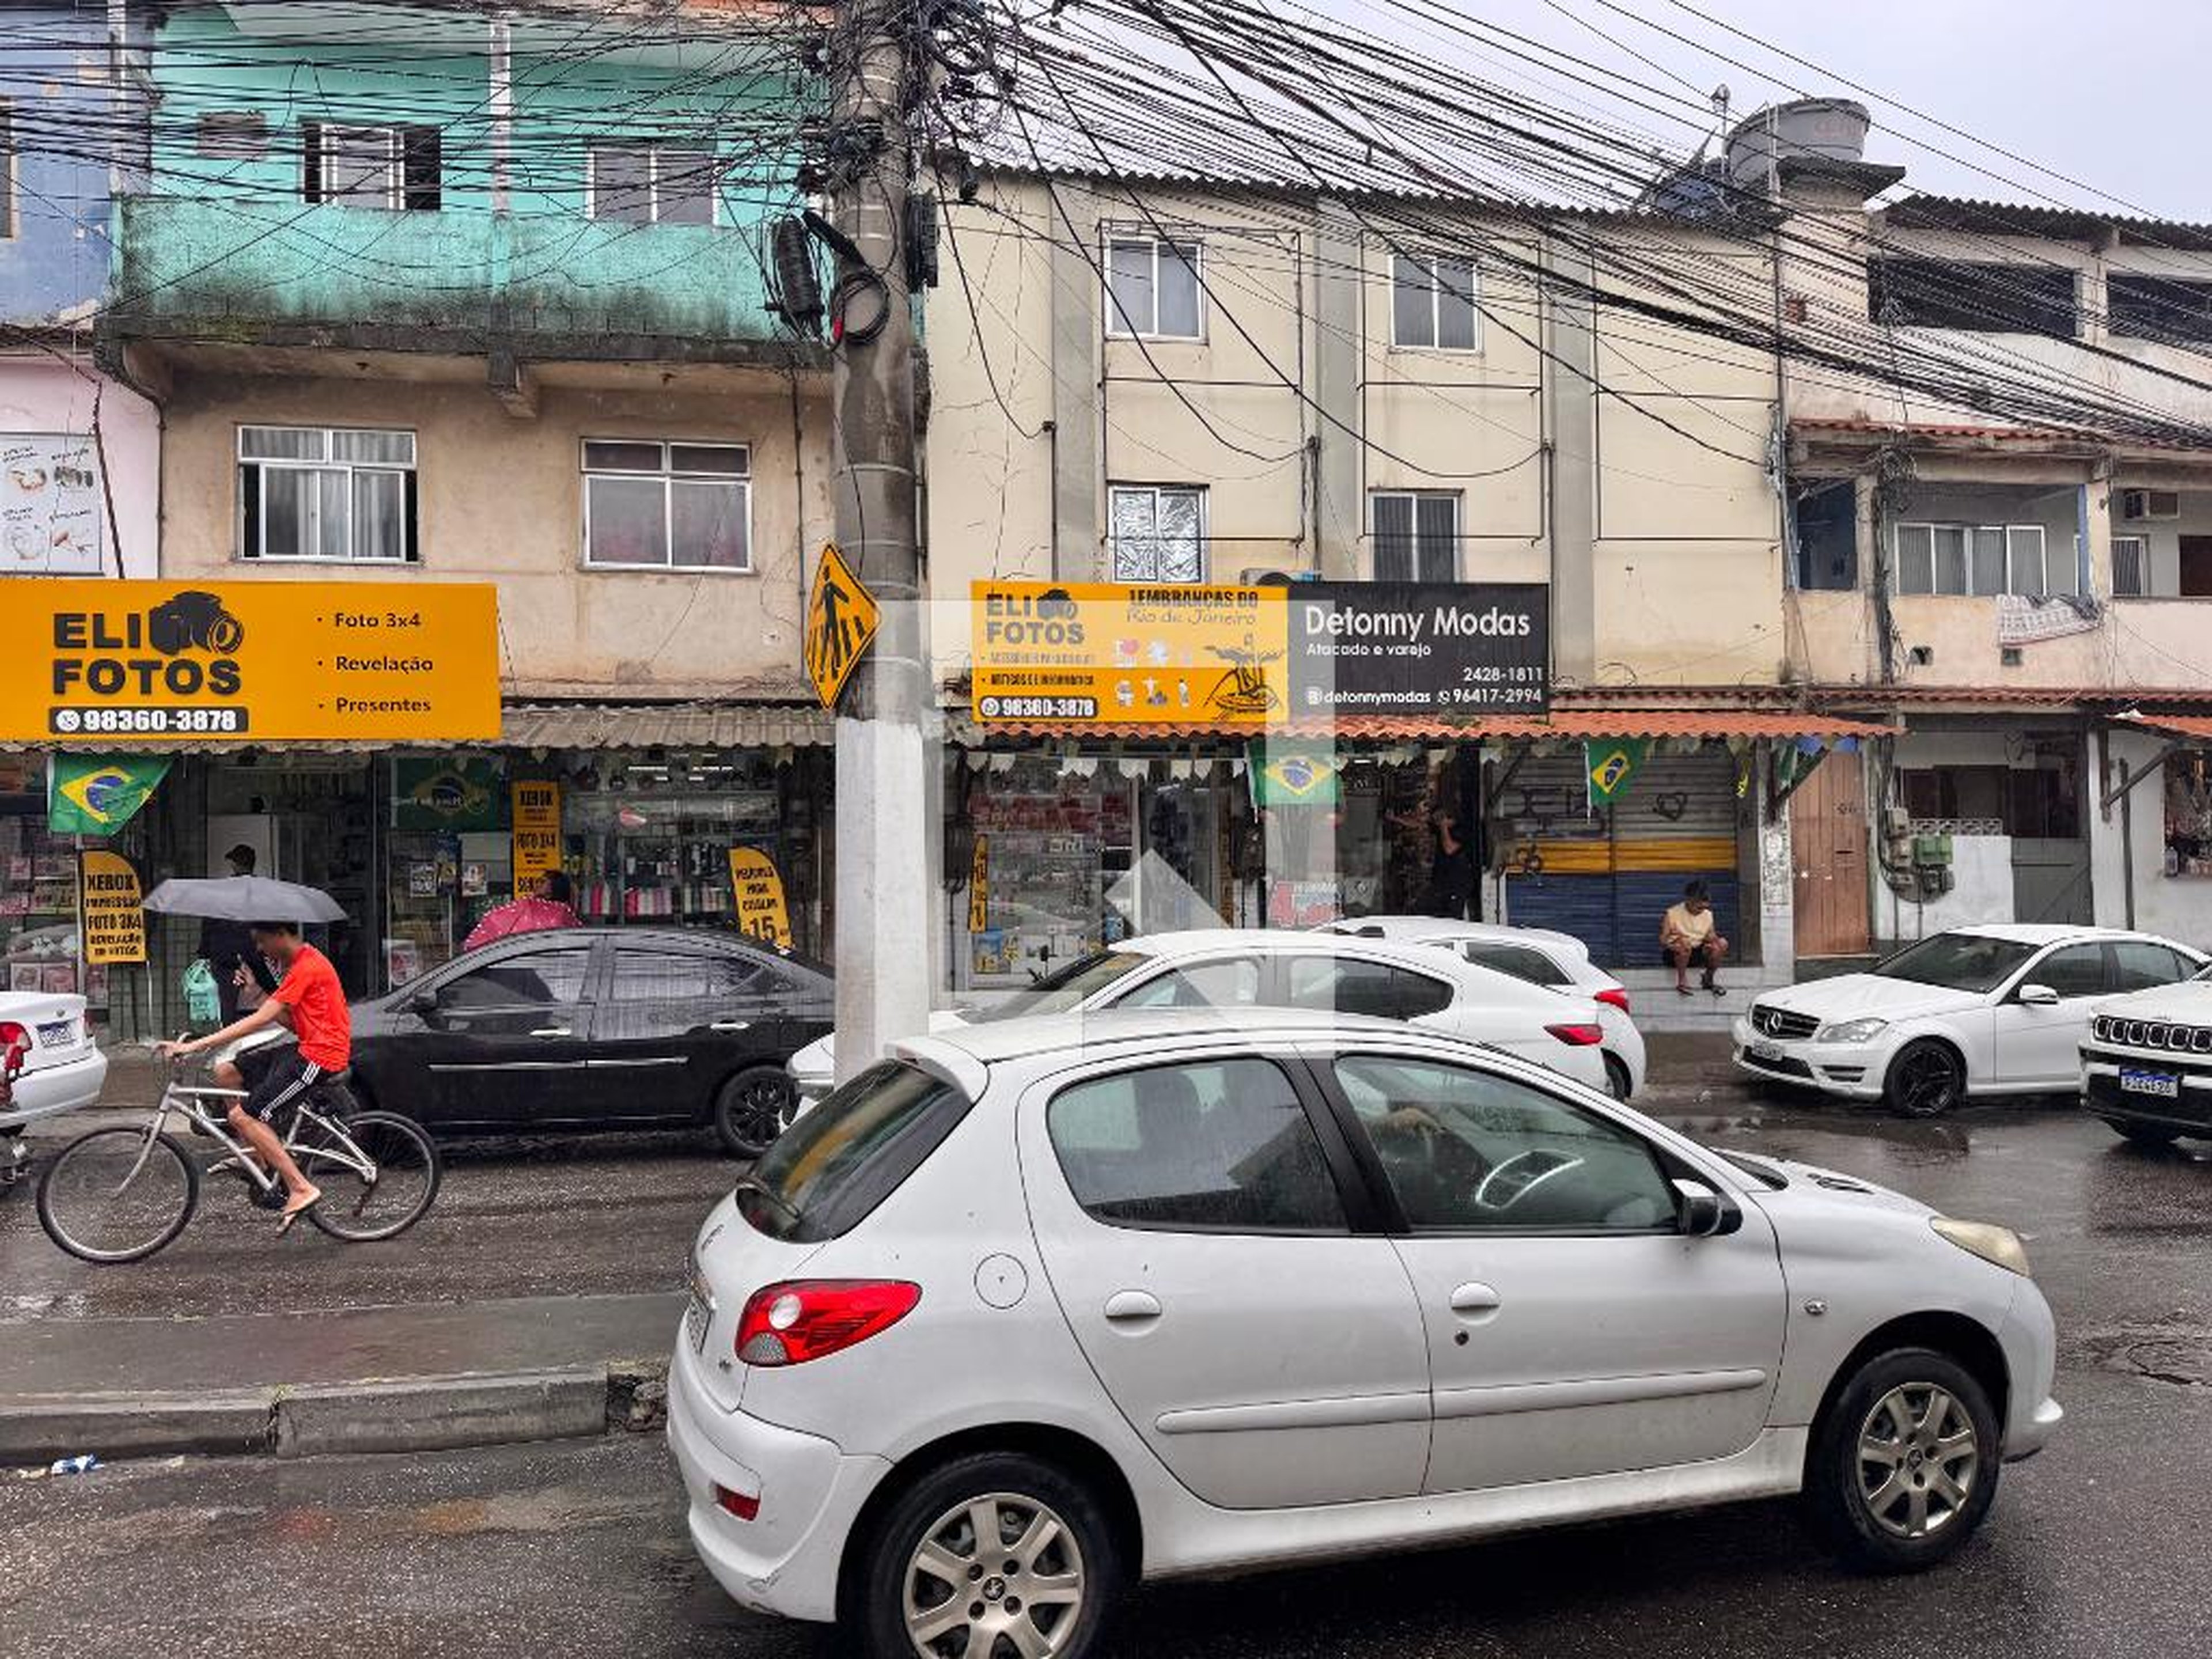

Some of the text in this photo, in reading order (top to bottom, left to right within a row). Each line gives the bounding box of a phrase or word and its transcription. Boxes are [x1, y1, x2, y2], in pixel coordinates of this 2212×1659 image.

[987, 594, 1031, 617] ELI
[335, 612, 422, 628] Foto 3x4
[1306, 606, 1530, 641] Detonny Modas
[54, 612, 141, 649] ELI
[987, 622, 1084, 645] FOTOS
[1306, 643, 1431, 657] Atacado e varejo
[336, 656, 434, 674] Revelação
[1463, 667, 1542, 681] 2428-1811
[52, 660, 242, 695] FOTOS
[336, 697, 431, 713] Presentes
[1453, 690, 1541, 703] 96417-2994
[83, 710, 237, 732] 98360-3878
